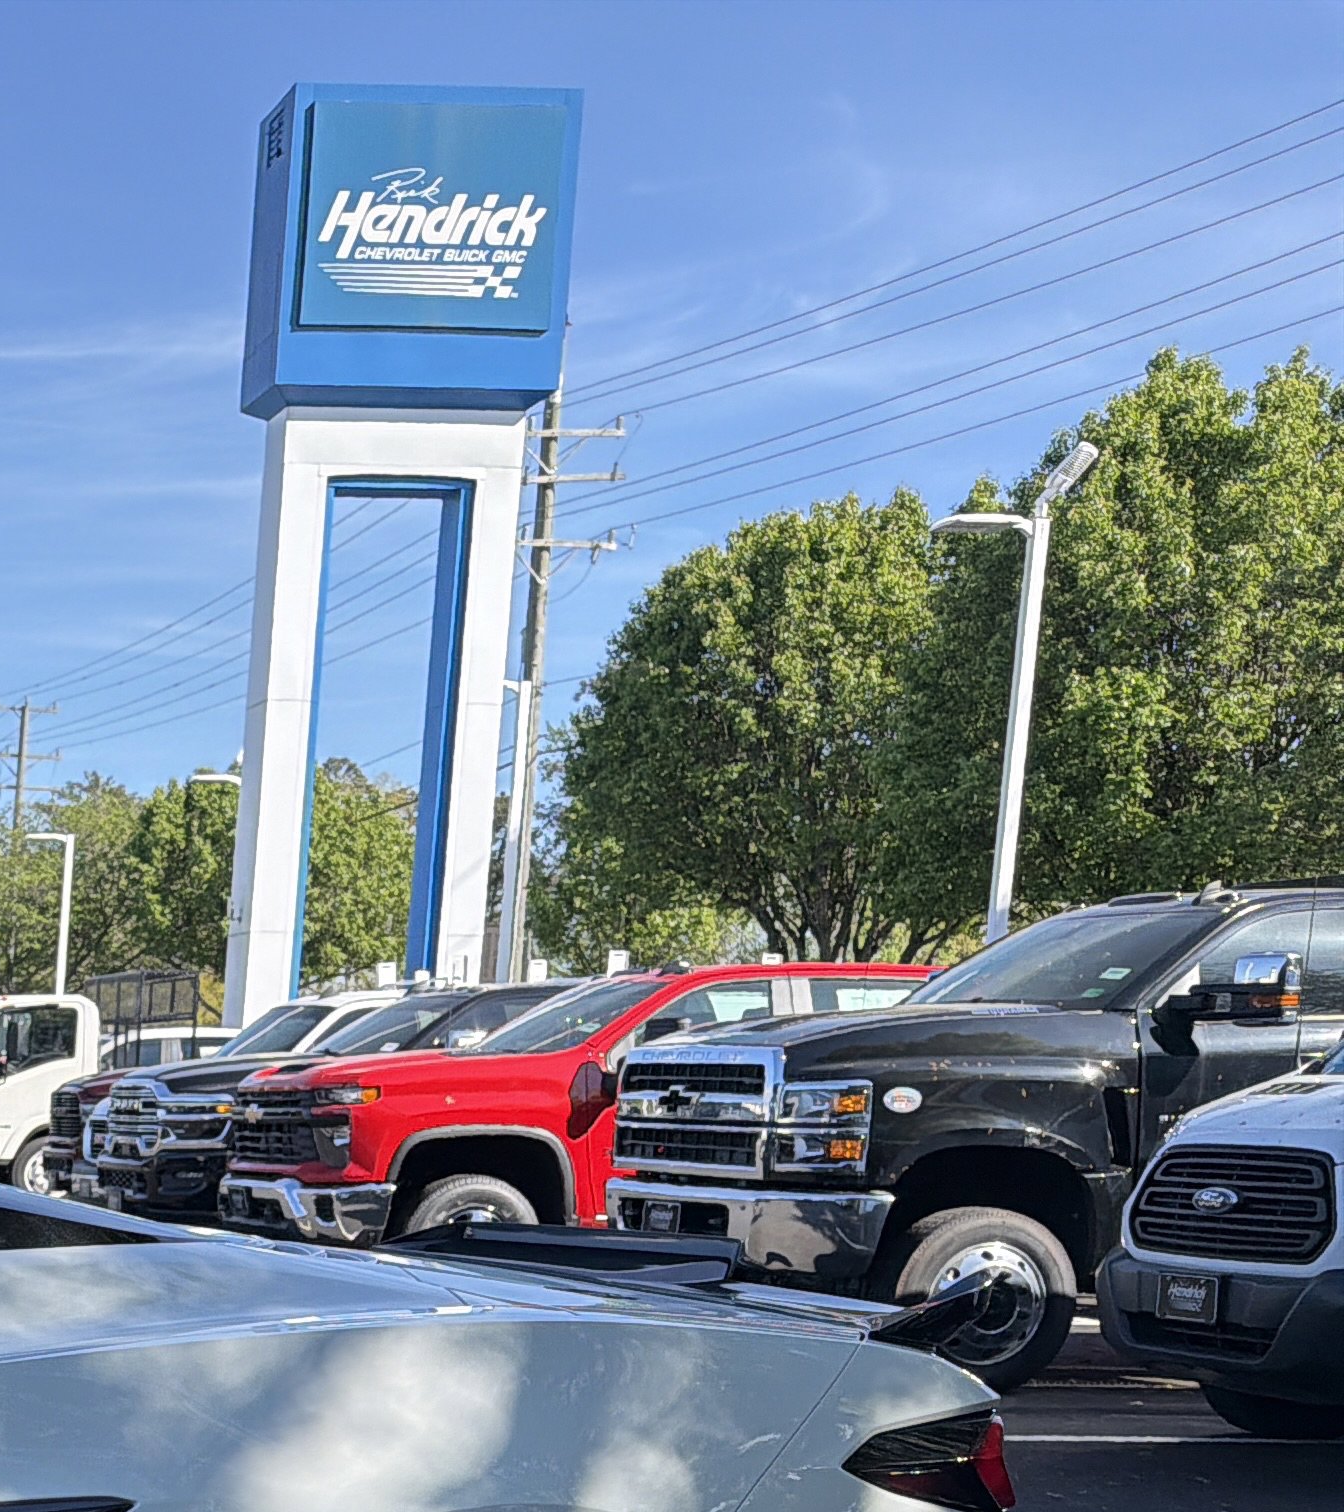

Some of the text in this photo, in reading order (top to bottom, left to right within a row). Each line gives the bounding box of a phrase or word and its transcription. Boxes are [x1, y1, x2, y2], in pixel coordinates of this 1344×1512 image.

[318, 190, 548, 260] Hendrick
[354, 246, 528, 264] CHEVROLET BUICK GMC
